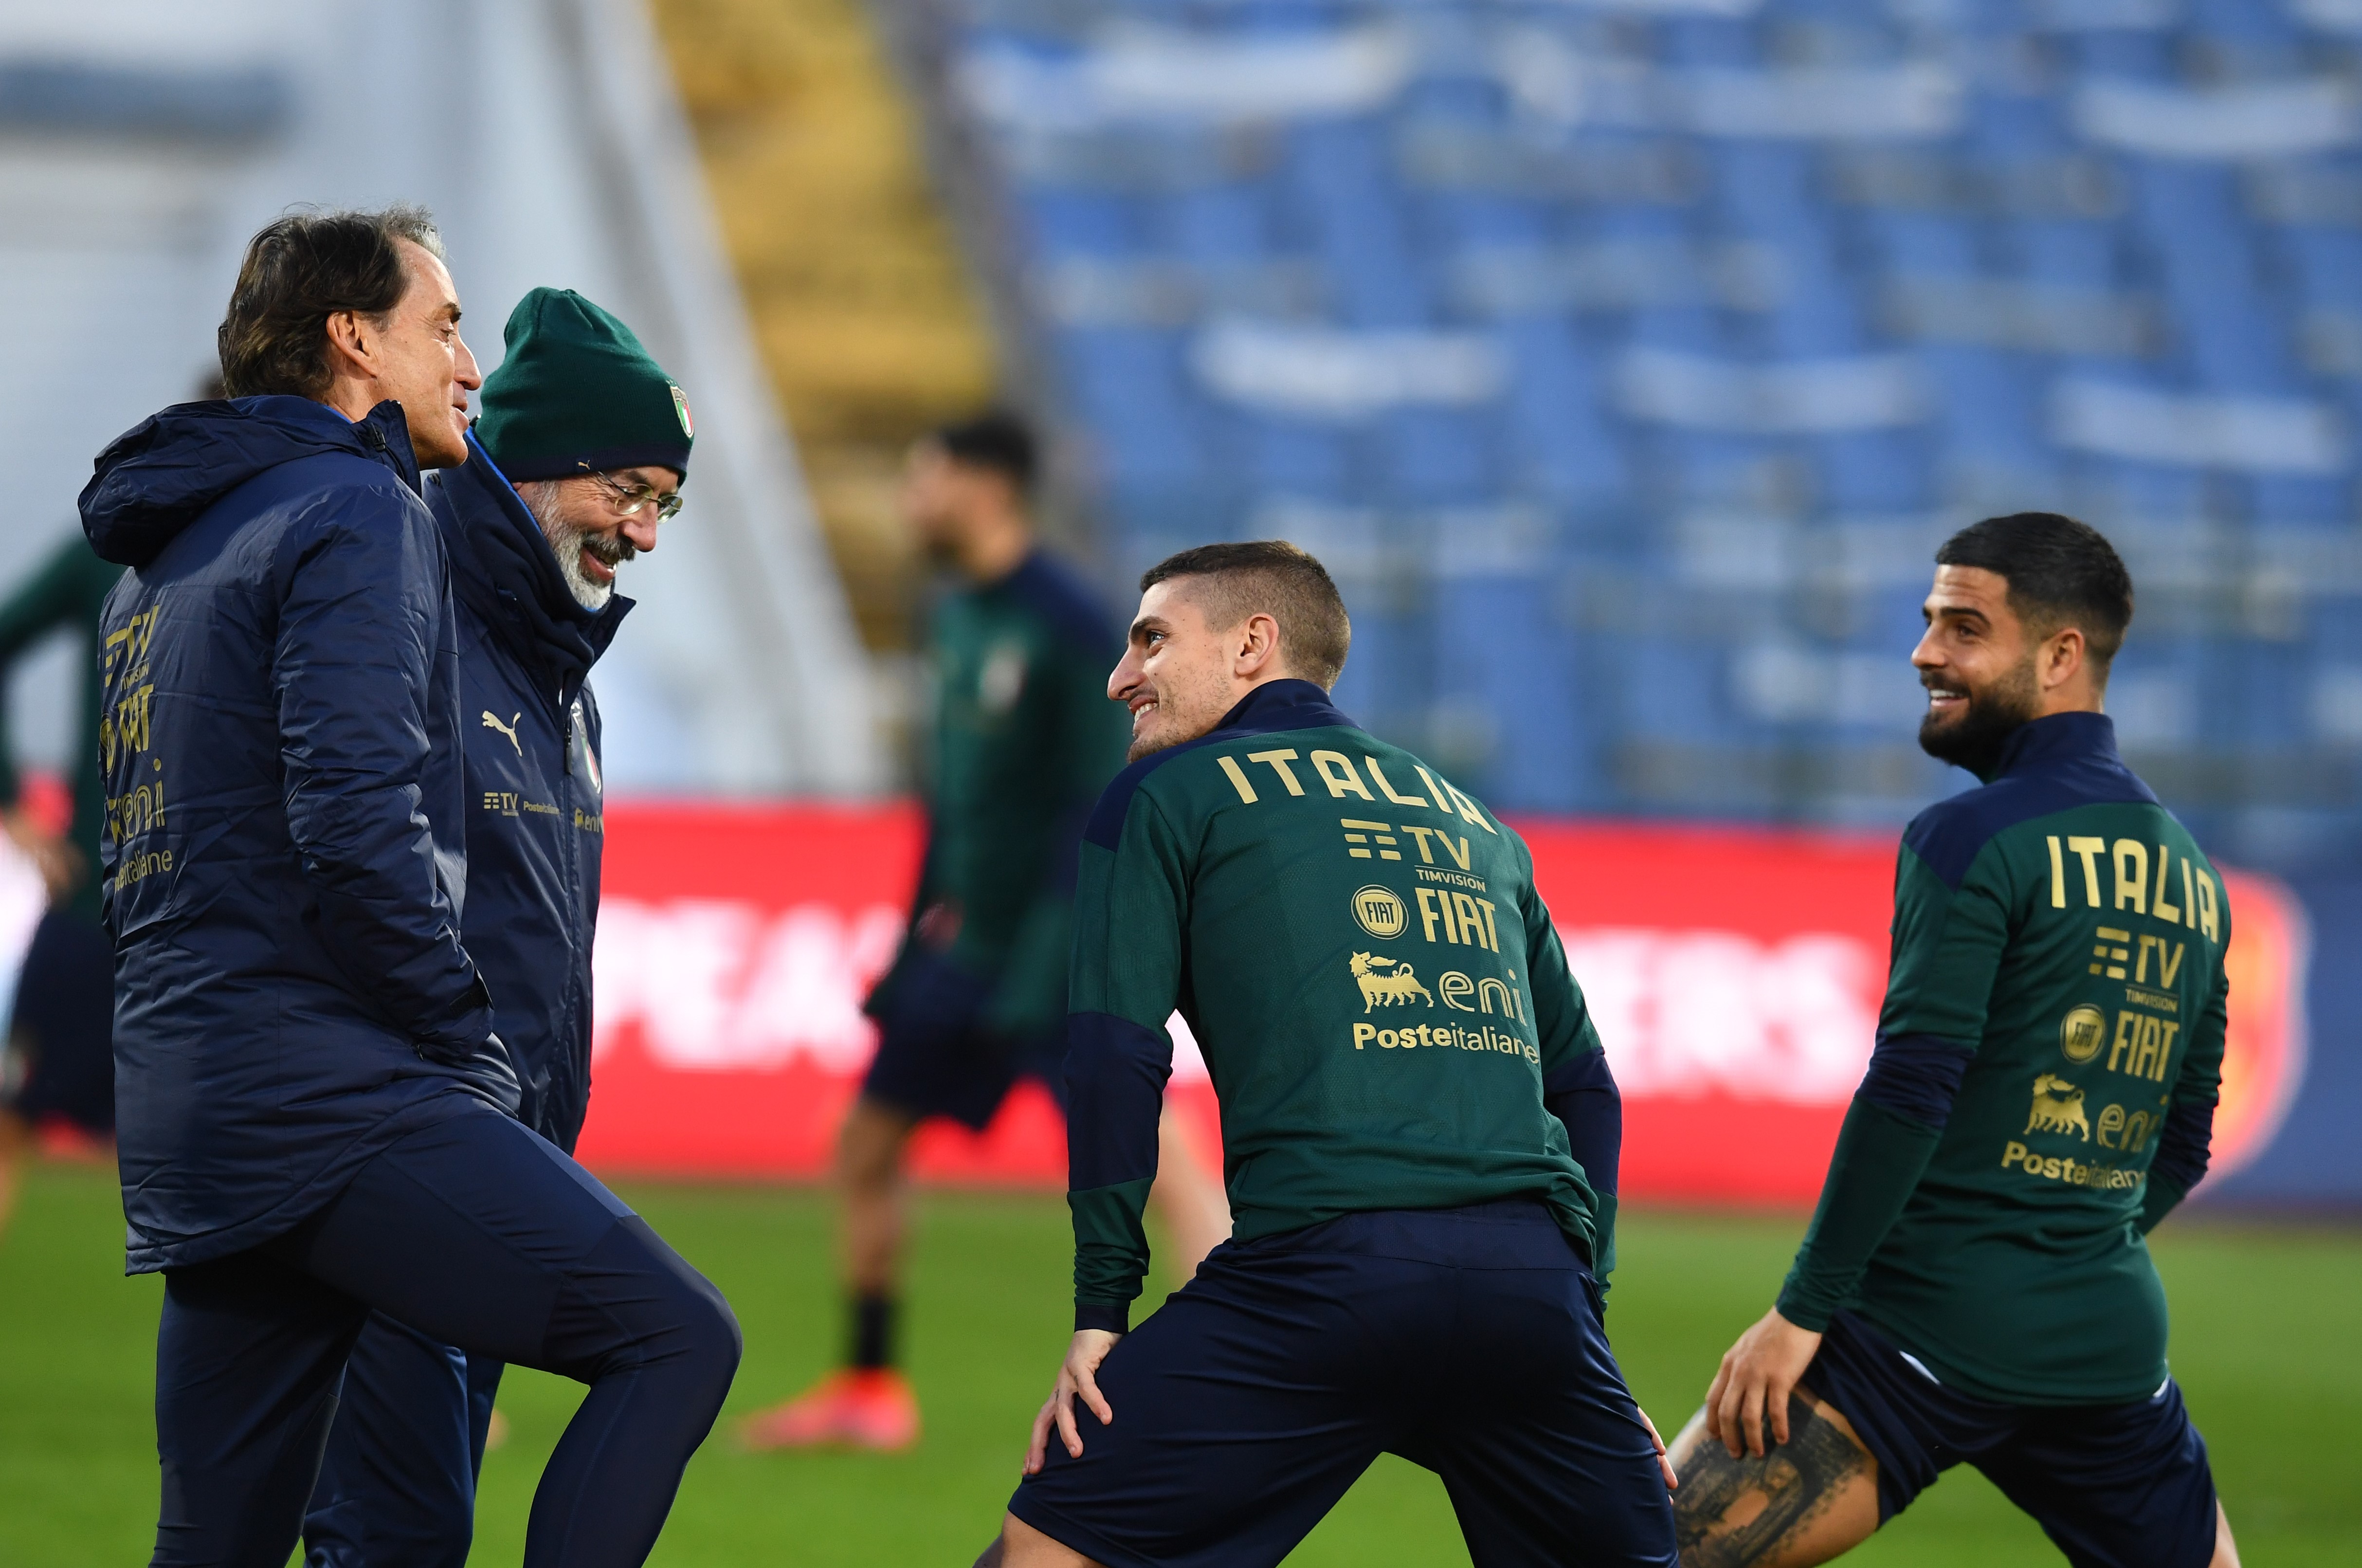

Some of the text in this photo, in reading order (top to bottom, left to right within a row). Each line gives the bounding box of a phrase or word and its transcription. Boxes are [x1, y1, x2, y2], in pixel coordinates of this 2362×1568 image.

[500, 792, 518, 809] TV
[1217, 748, 1498, 835] ITALIA
[1401, 825, 1470, 871] TV
[1416, 869, 1486, 893] TIMVISION
[2046, 835, 2219, 944] ITALIA
[1365, 901, 1394, 925] FIAT
[1415, 887, 1499, 953] FIAT
[2135, 934, 2185, 989] TV
[1438, 969, 1527, 1026] eni
[1353, 1021, 1539, 1064] Posteitaliane
[2107, 1009, 2180, 1082] FIAT
